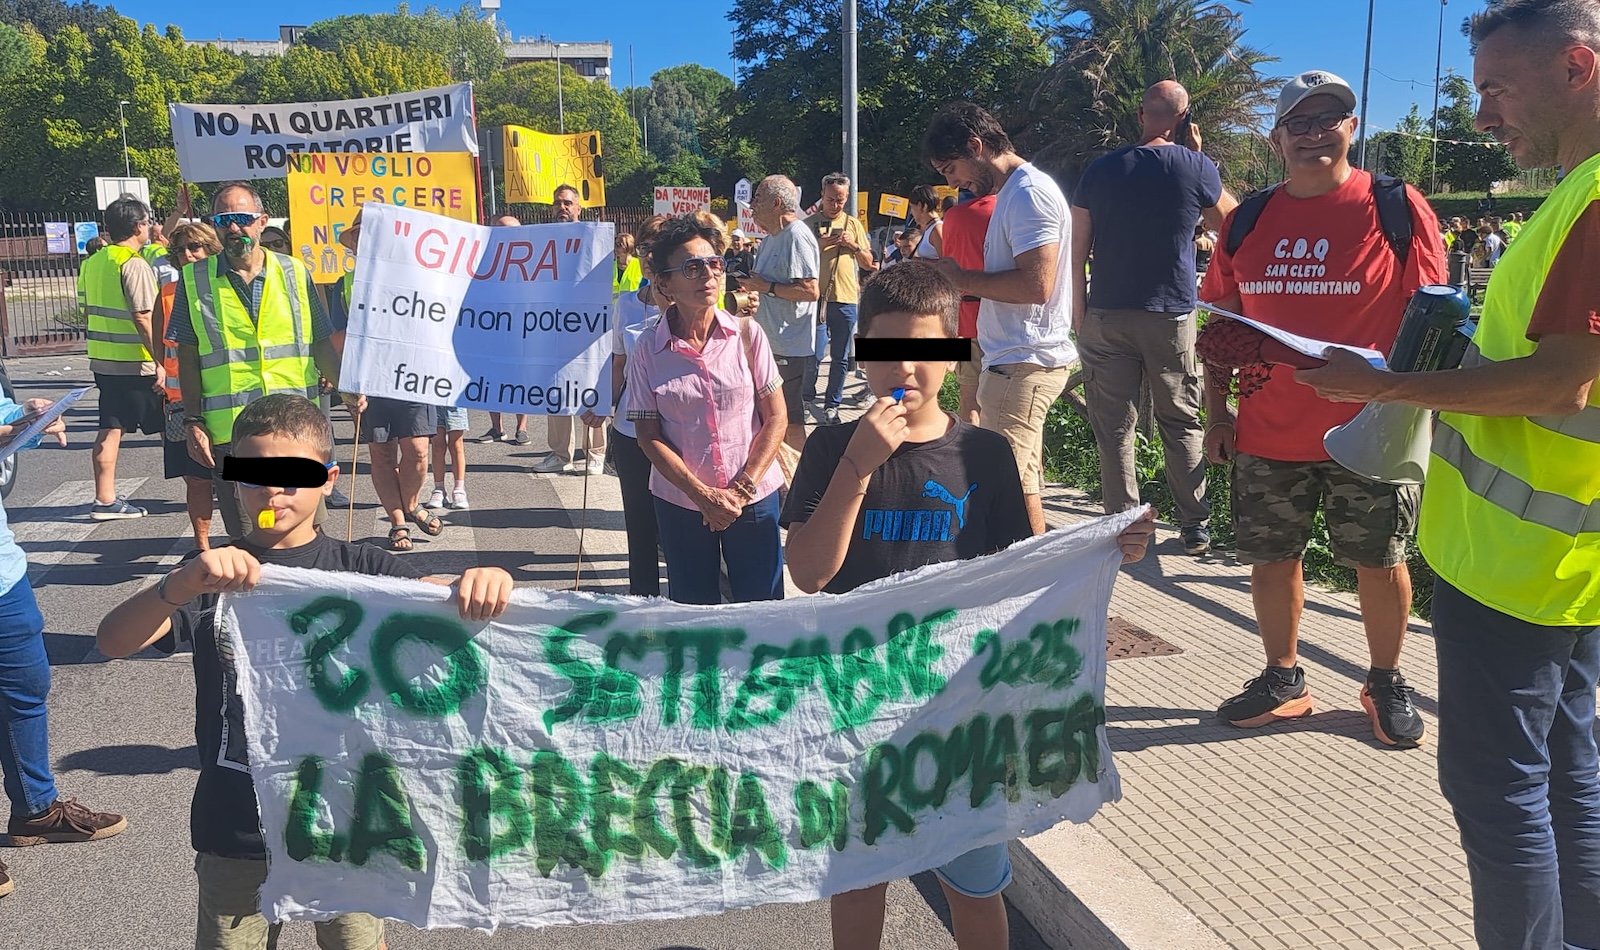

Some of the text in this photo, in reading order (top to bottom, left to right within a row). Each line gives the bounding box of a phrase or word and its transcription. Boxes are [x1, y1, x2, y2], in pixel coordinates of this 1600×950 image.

[194, 94, 451, 137] NO AI QUARTIERI
[287, 153, 432, 177] NON VOGLIO
[309, 185, 462, 209] CRESCERE
[655, 188, 709, 204] DA POLMONE
[741, 221, 756, 234] VIA
[394, 220, 581, 281] "GIURA"
[1274, 238, 1330, 261] C.D.Q
[1265, 264, 1326, 277] SAN CLETO
[1285, 281, 1361, 295] NOMENTANO
[458, 306, 512, 331] non
[523, 305, 609, 338] potevi
[394, 363, 599, 414] fare di meglio
[863, 510, 952, 541] PUMA
[290, 596, 490, 716] 20
[973, 617, 1083, 690] 2025
[286, 754, 428, 873] LA
[460, 745, 788, 878] BRECCIA
[794, 779, 848, 851] DI
[864, 713, 1020, 845] ROMA
